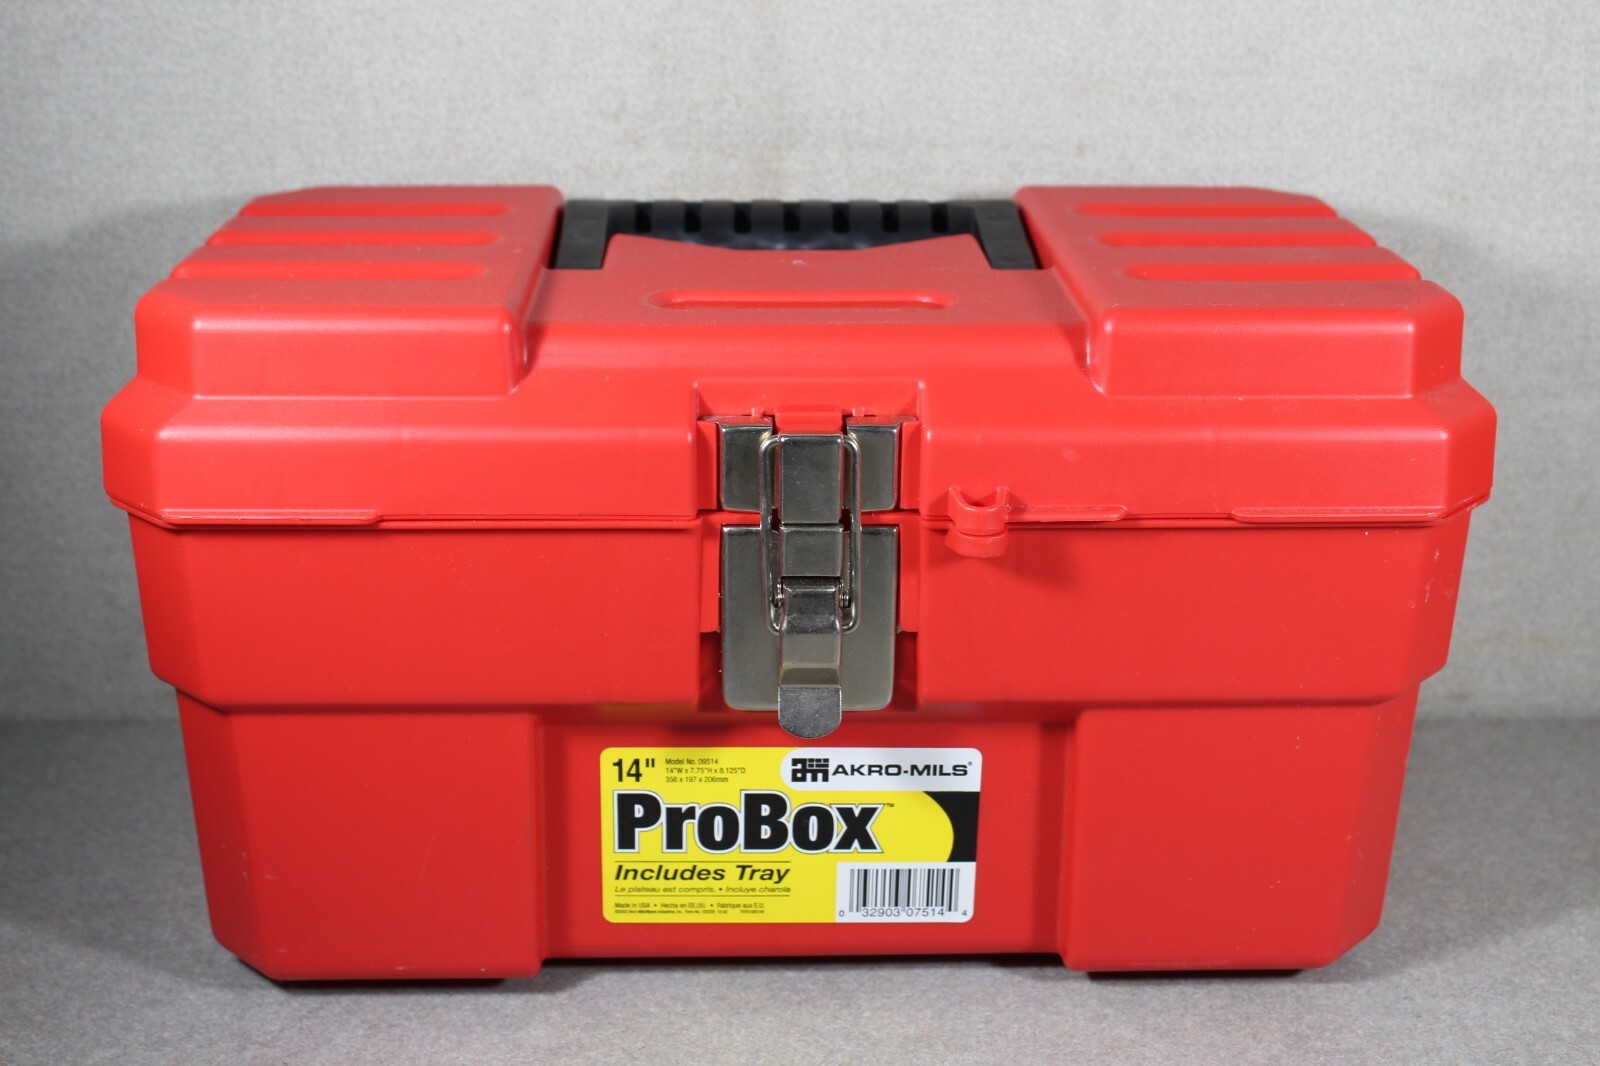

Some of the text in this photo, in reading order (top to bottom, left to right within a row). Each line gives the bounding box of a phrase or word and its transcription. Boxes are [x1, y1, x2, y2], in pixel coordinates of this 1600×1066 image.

[612, 757, 655, 783] 14"
[614, 864, 790, 884] Includes Tray
[627, 886, 660, 894] plateau
[725, 886, 757, 894] Incluye
[838, 909, 845, 917] 0
[861, 908, 901, 917] 32903
[906, 908, 945, 917] 07514
